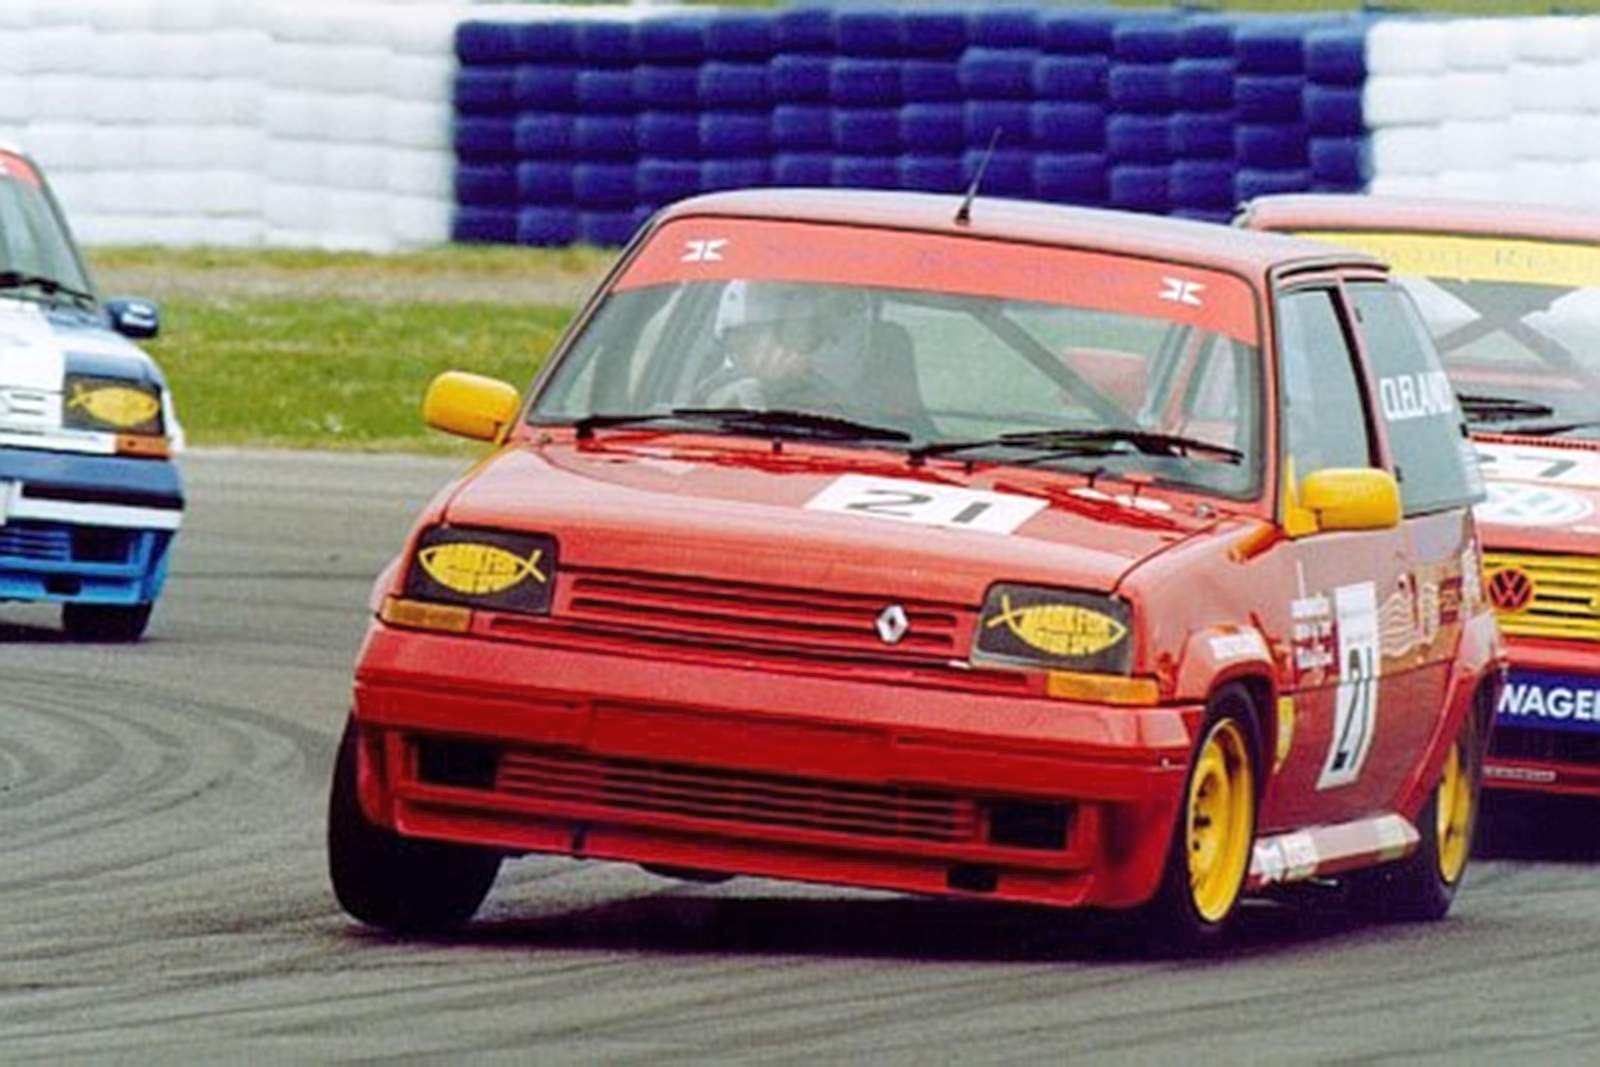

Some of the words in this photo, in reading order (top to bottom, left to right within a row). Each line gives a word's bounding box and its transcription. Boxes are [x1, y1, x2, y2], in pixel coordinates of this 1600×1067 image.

[845, 488, 993, 524] 21
[1331, 648, 1373, 773] 21
[1498, 683, 1600, 722] WAGE
